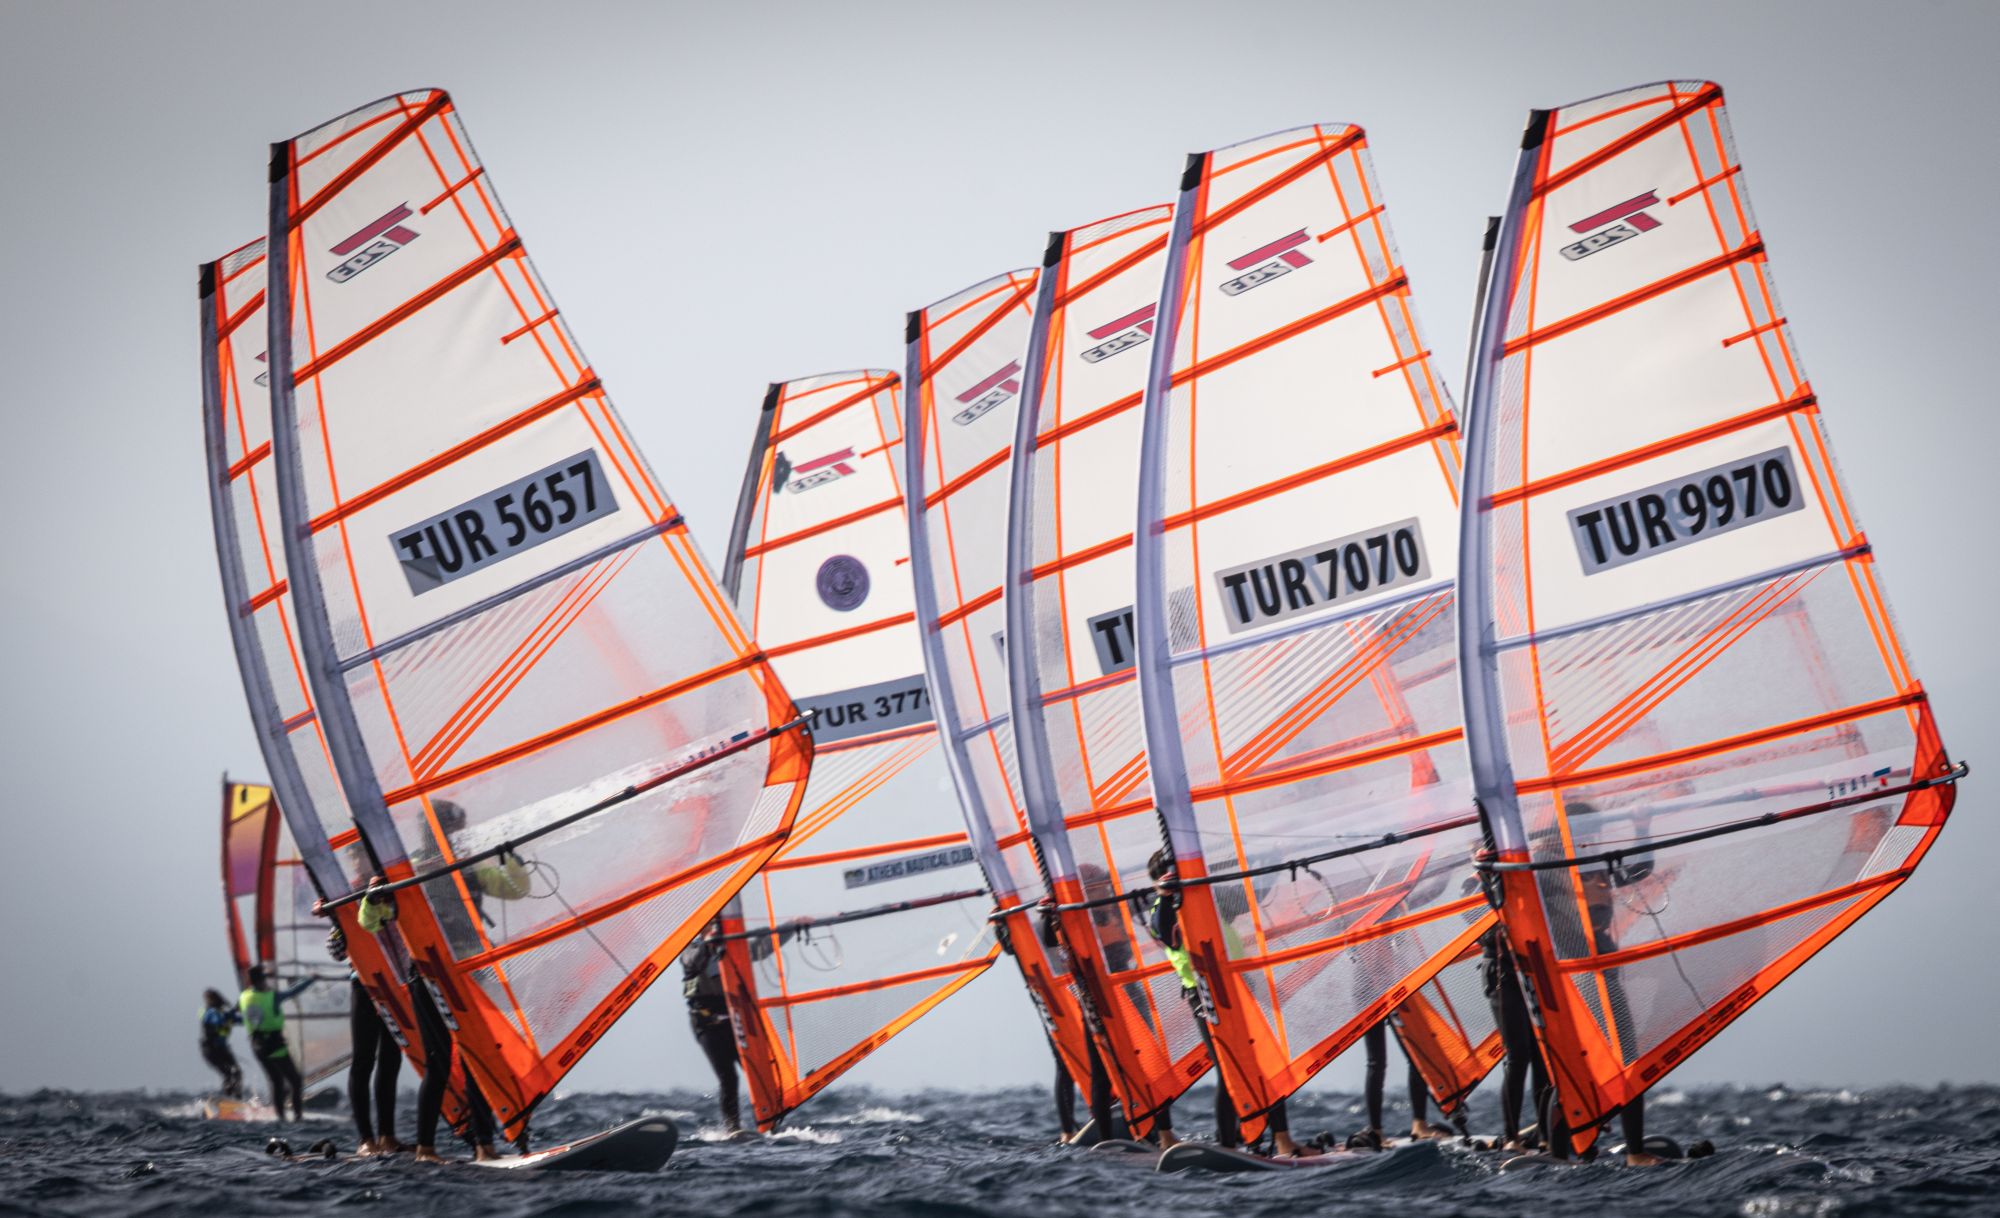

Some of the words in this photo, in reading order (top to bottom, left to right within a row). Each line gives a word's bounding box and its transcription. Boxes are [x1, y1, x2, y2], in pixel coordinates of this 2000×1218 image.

[398, 508, 498, 573] TUR
[494, 459, 597, 547] 5657
[1576, 494, 1677, 565] TUR
[1679, 458, 1792, 536] 9970
[1223, 558, 1314, 624] TUR
[1315, 528, 1419, 601] 7070
[810, 702, 868, 731] TUR
